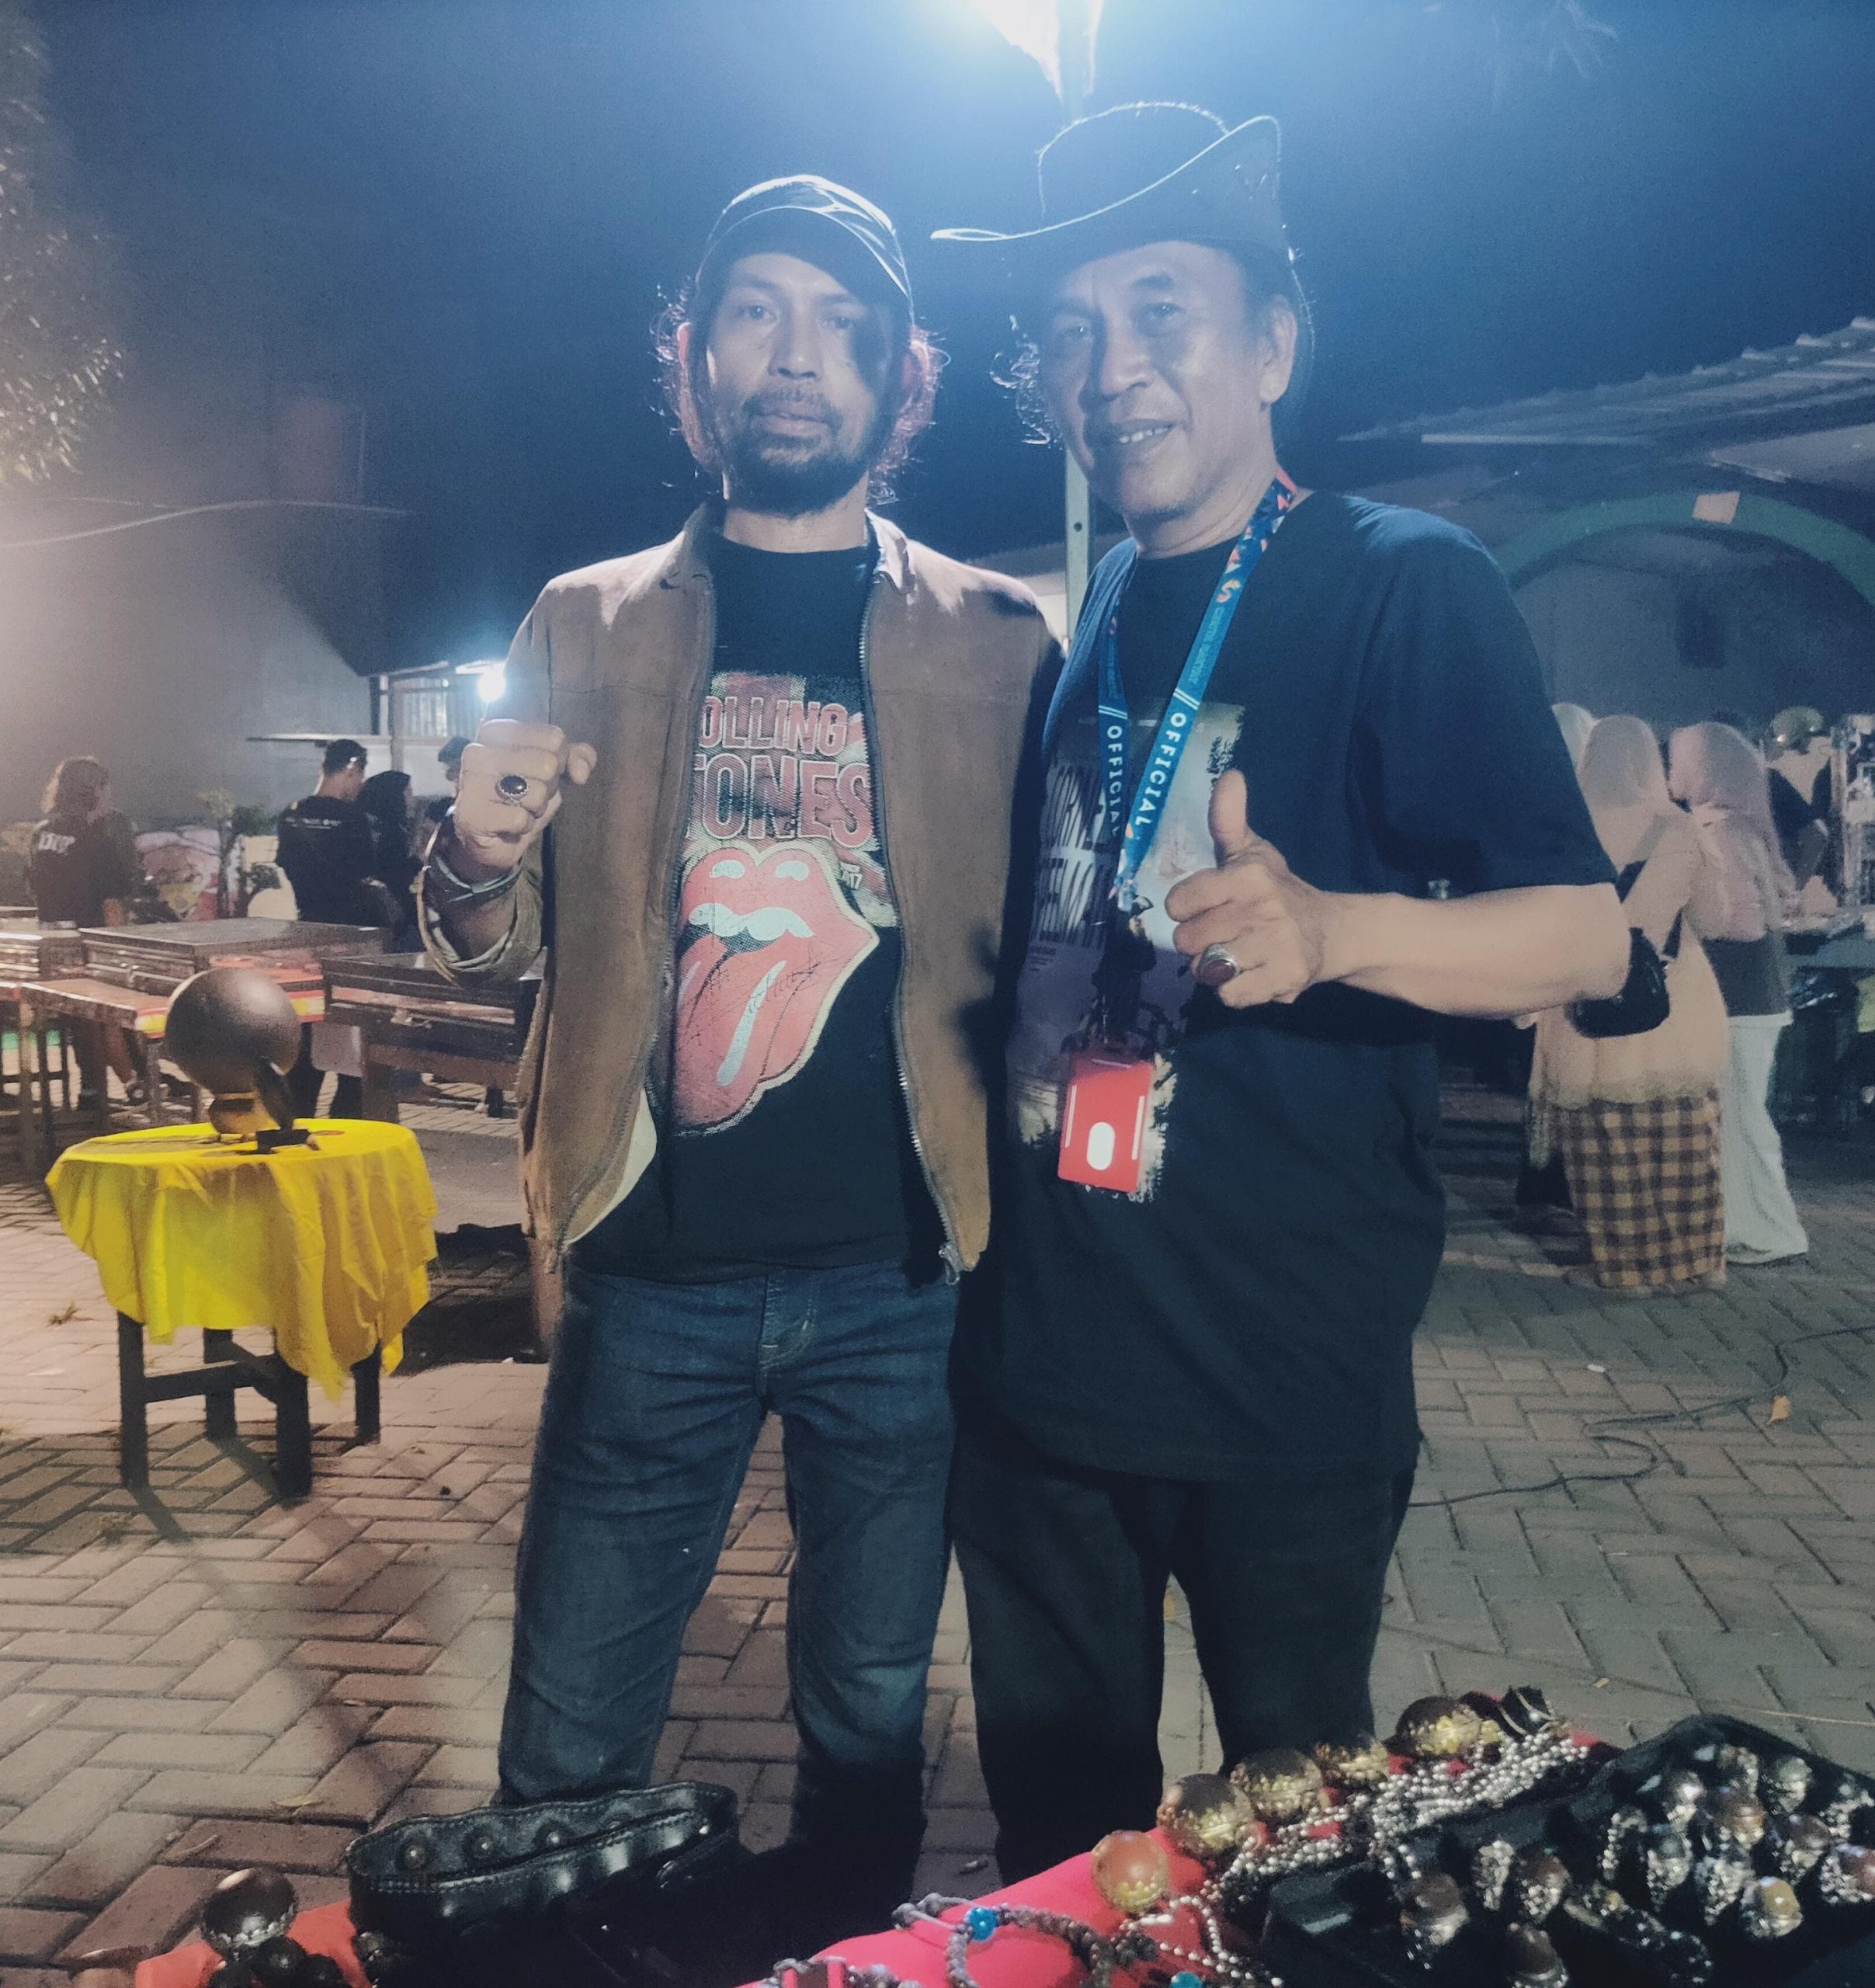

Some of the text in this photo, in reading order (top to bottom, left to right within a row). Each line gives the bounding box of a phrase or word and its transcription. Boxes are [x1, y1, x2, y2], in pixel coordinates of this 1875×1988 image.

[698, 696, 849, 756] OLLING
[1134, 711, 1186, 826] OFFICIAL
[695, 752, 875, 848] ONES
